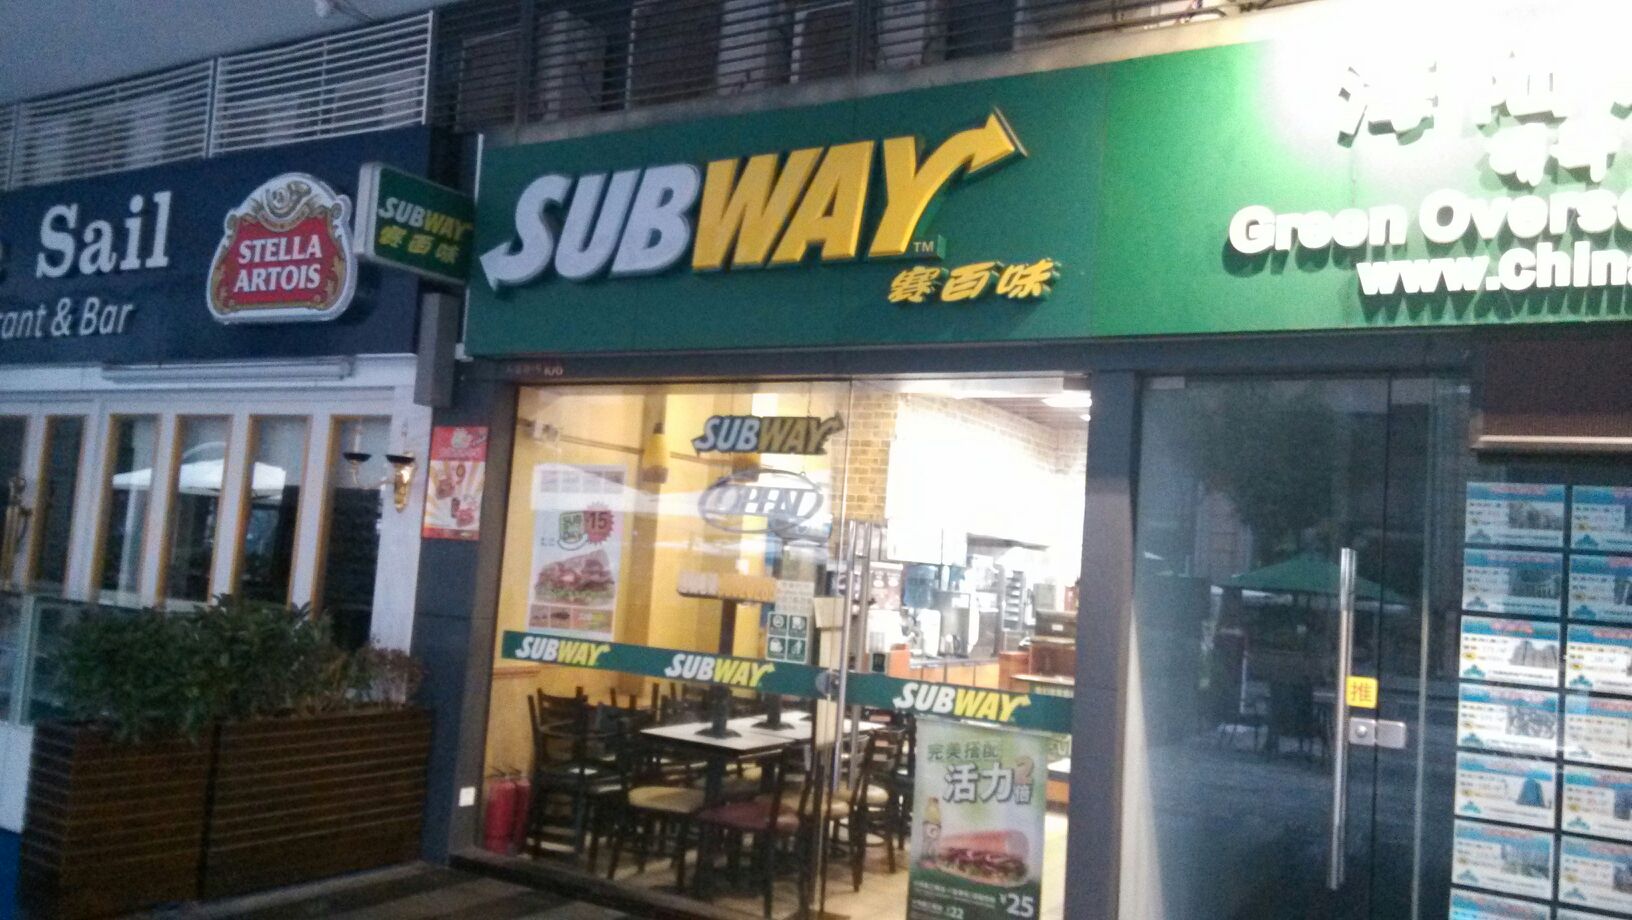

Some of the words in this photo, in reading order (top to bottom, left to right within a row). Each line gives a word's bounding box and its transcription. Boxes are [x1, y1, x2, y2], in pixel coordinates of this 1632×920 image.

[378, 197, 473, 240] SUBWAY
[479, 106, 1027, 291] SUBWAY
[36, 191, 172, 278] Sail
[238, 235, 322, 264] STELLA
[914, 241, 935, 253] TM
[1229, 204, 1408, 254] Green
[234, 264, 321, 293] ARTOIS
[1356, 240, 1632, 295] www.Chin
[0, 304, 46, 339] ant
[51, 297, 72, 336] &
[79, 297, 133, 336] Bar
[691, 412, 845, 456] SUBWAY
[515, 636, 611, 667] SUBWAY
[664, 653, 775, 688] SUBWAY
[892, 683, 1031, 722] SUBWAY
